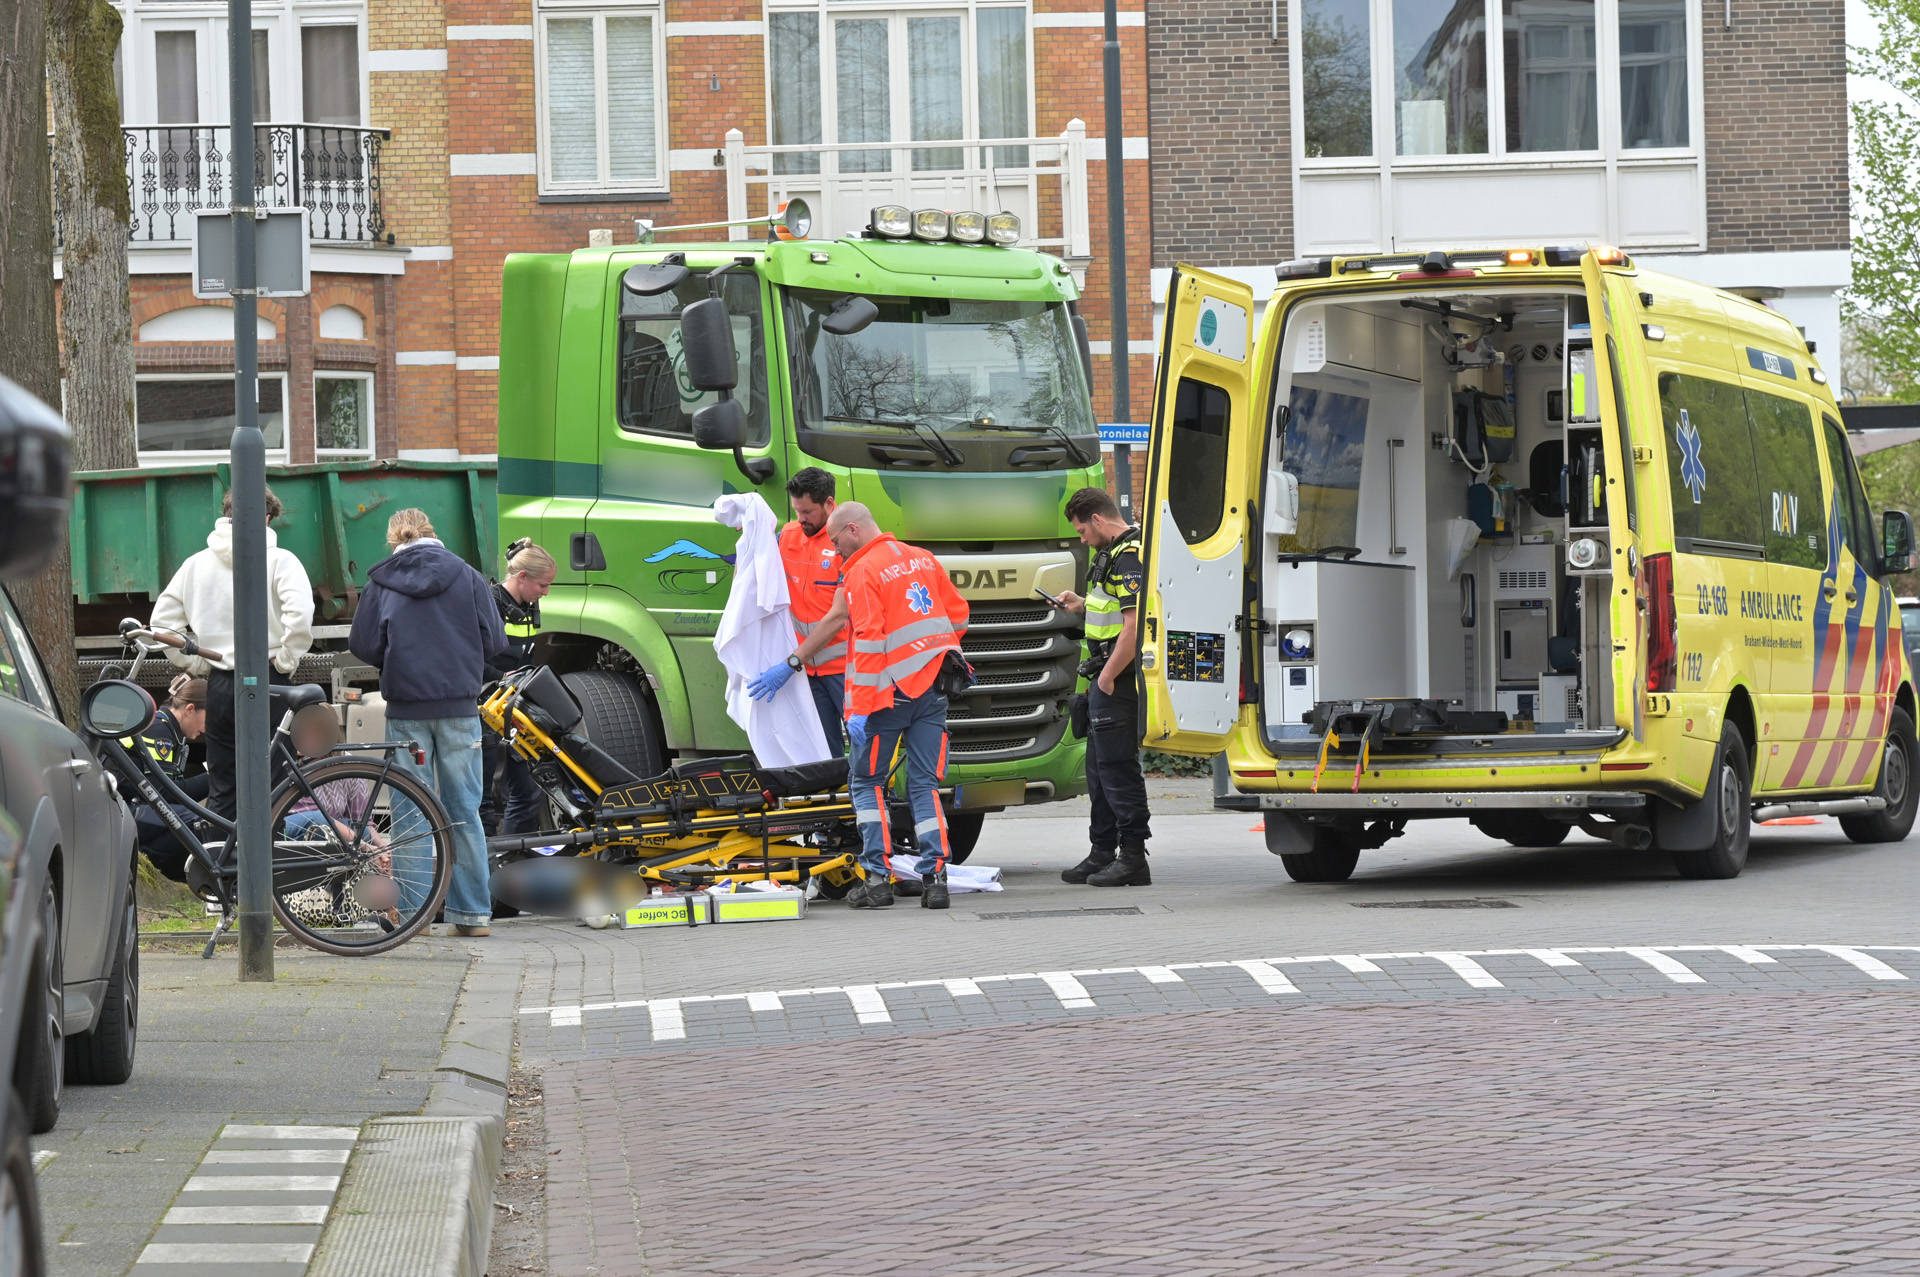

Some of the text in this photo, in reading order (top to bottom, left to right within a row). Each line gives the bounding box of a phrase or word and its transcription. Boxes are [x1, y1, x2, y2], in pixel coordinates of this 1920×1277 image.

[1098, 429, 1149, 439] aronielaa
[949, 569, 1017, 589] DAF
[1696, 583, 1803, 622] 20-168 AMBULANCE
[639, 909, 688, 921] BC koffer
